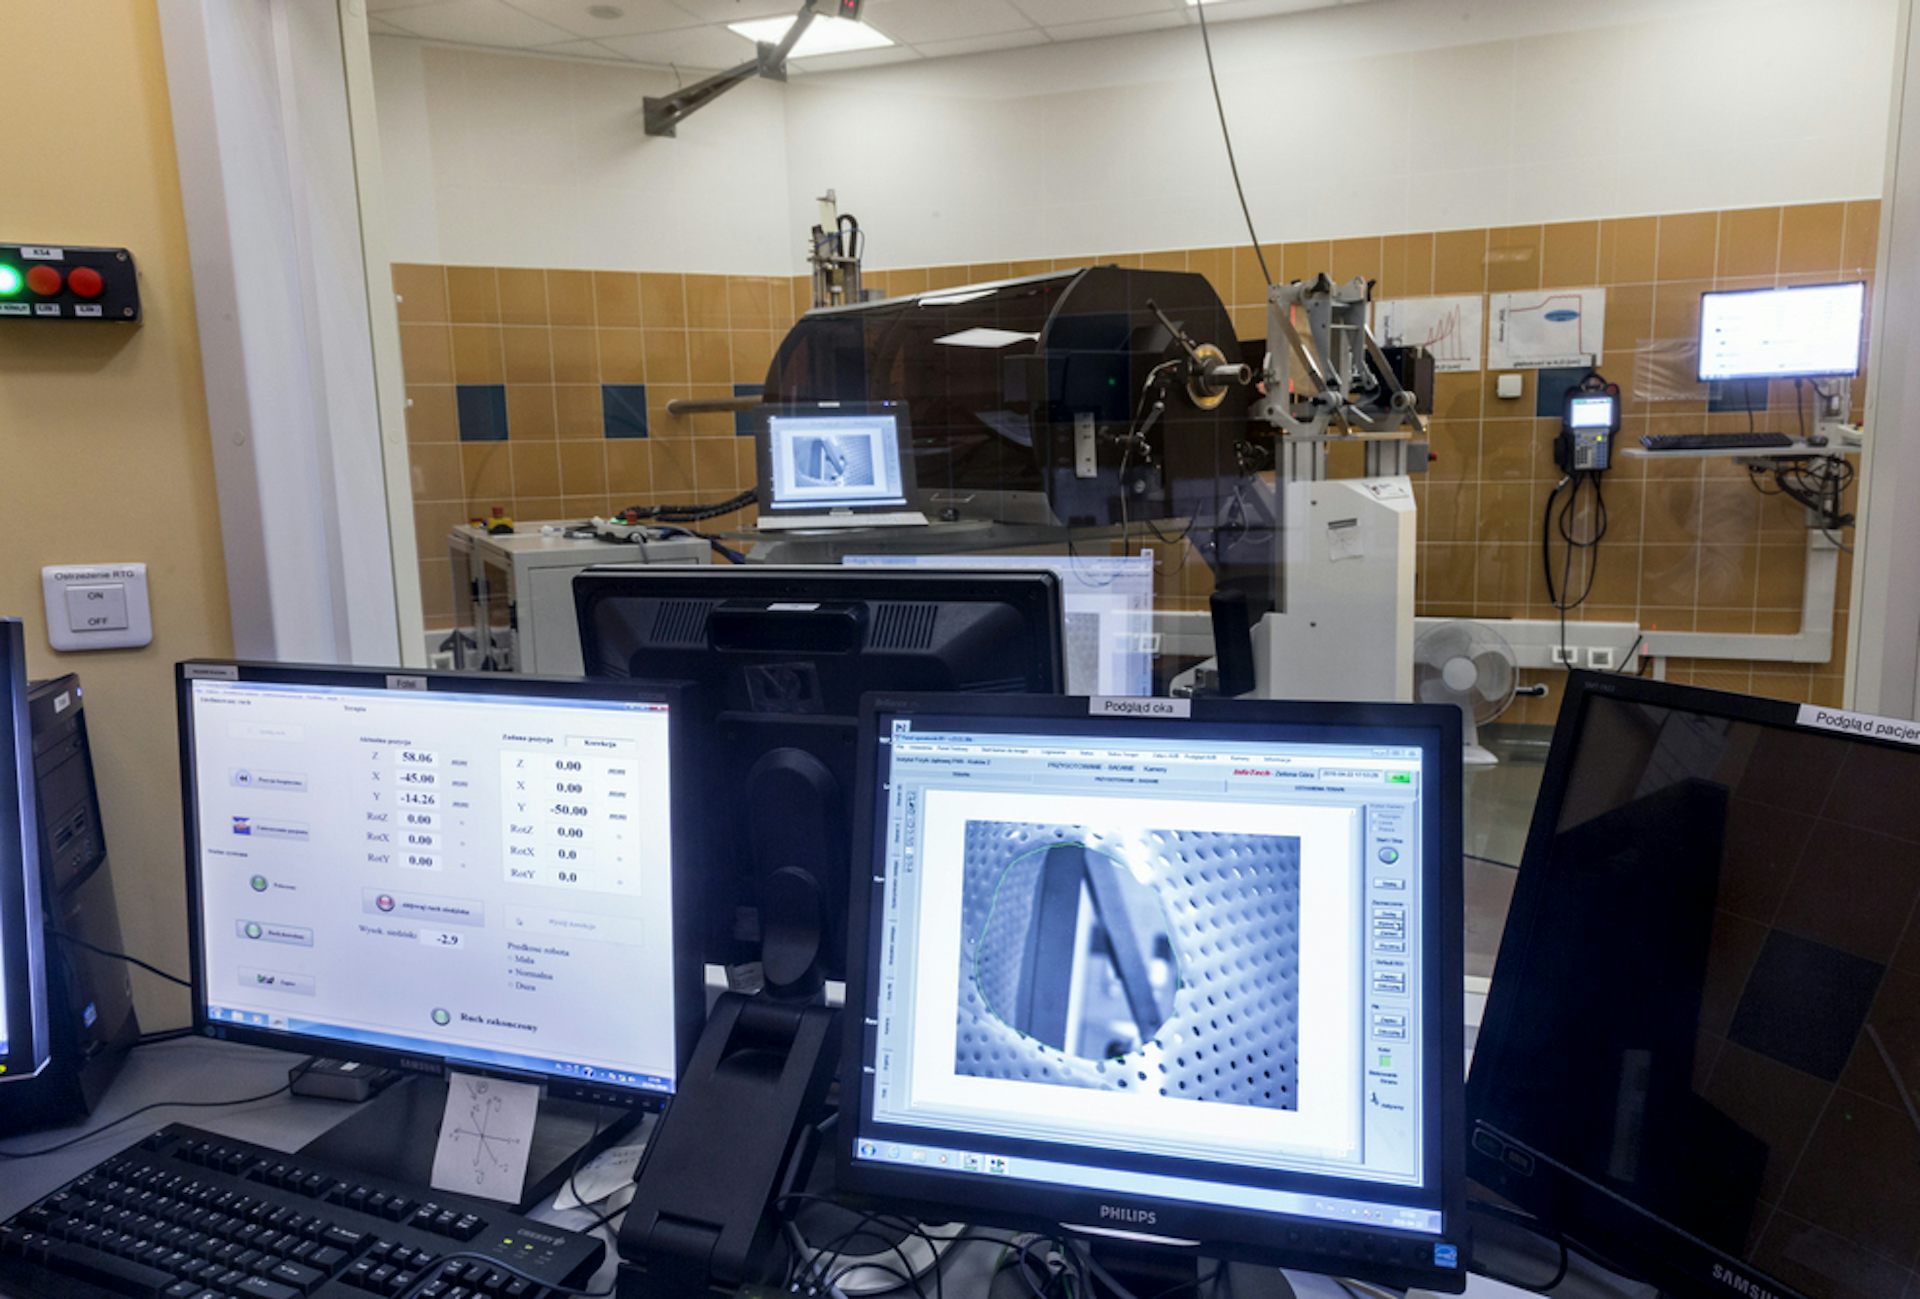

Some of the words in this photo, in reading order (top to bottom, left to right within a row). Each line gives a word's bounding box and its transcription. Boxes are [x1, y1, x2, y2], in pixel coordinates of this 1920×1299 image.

[113, 570, 135, 578] RTG
[87, 592, 104, 600] ON
[88, 617, 109, 626] OFF
[1104, 701, 1148, 714] Podgląd
[1153, 703, 1173, 714] oka
[1816, 711, 1874, 732] Podgląd
[402, 752, 433, 764] 58.06
[555, 760, 582, 772] 0.00
[372, 771, 381, 781] X
[400, 773, 435, 784] -45.00
[517, 780, 525, 790] X
[556, 782, 583, 794] 0.00
[372, 791, 381, 801] Y
[400, 794, 435, 806] -14.26
[517, 802, 526, 812] Y
[550, 804, 588, 817] -50.00
[367, 812, 388, 822] RotZ
[407, 814, 431, 825] 0.00
[510, 823, 534, 835] RotZ
[557, 827, 583, 839] 0.00
[367, 832, 390, 843] RotX
[408, 834, 432, 846] 0.00
[510, 845, 535, 857] RotX
[558, 849, 577, 860] 0.0
[367, 853, 390, 864] RotY
[408, 855, 433, 867] 0.00
[510, 868, 535, 879] RotY
[558, 871, 577, 883] 0.0
[436, 934, 458, 945] -2.9
[460, 1012, 484, 1024] Ruch
[1100, 1205, 1157, 1225] PHILIPS
[1712, 1263, 1781, 1299] SAMSU
